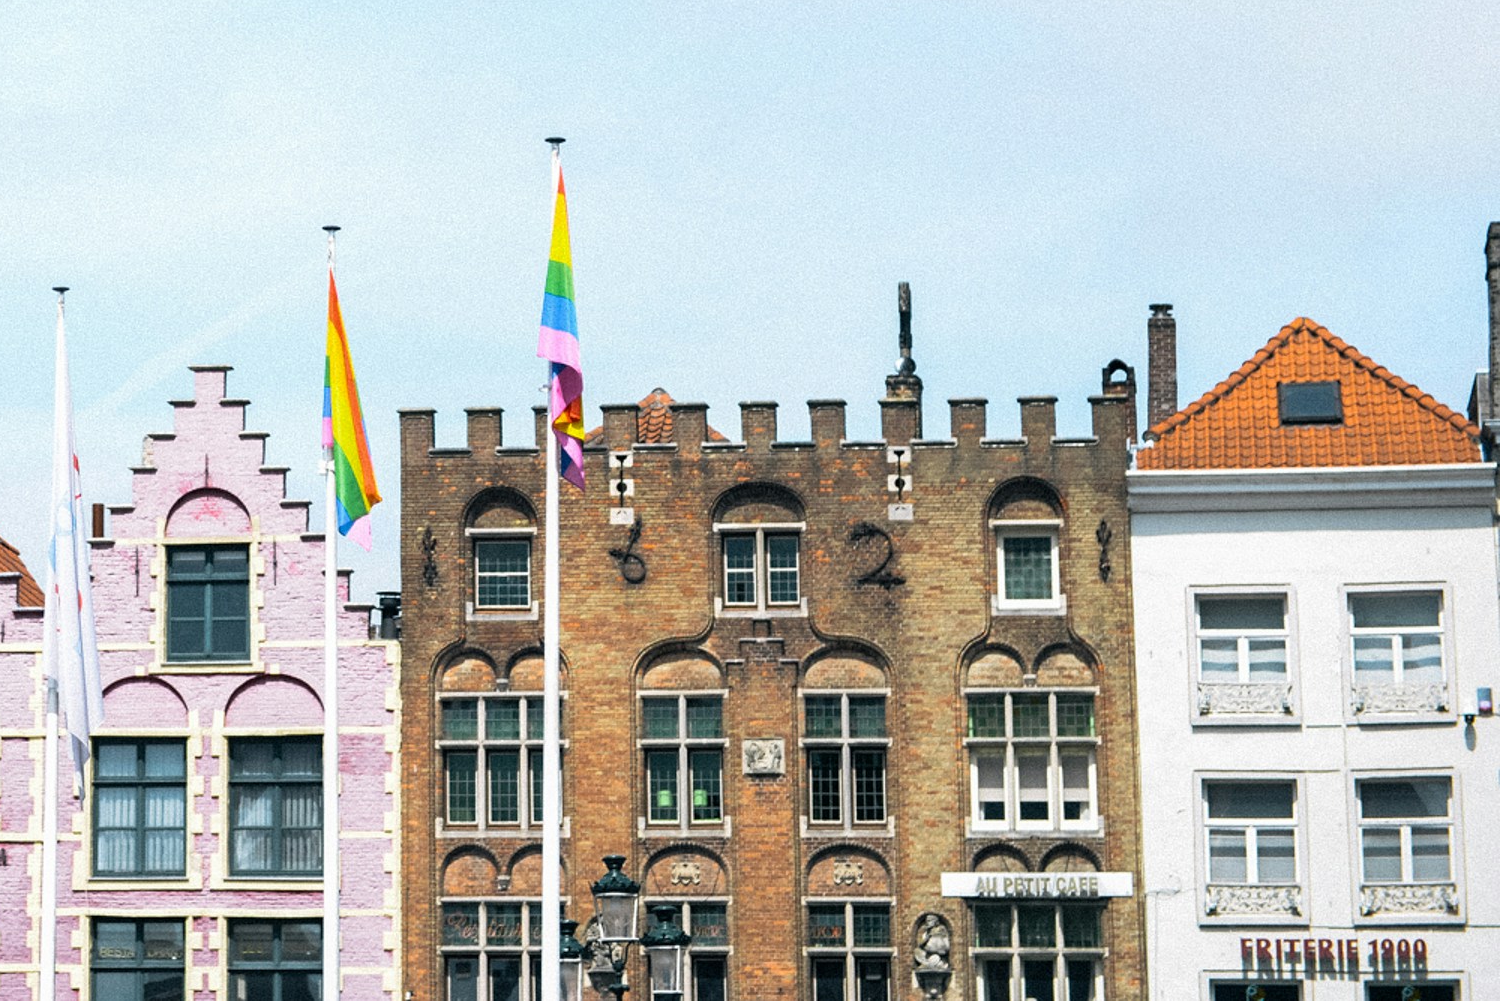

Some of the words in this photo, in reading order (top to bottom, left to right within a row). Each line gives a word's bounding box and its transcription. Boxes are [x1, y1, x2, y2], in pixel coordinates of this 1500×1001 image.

[975, 876, 998, 894] AU
[1003, 876, 1049, 895] PETIT
[1240, 938, 1359, 960] FRITERIE
[1368, 938, 1428, 960] 1900
